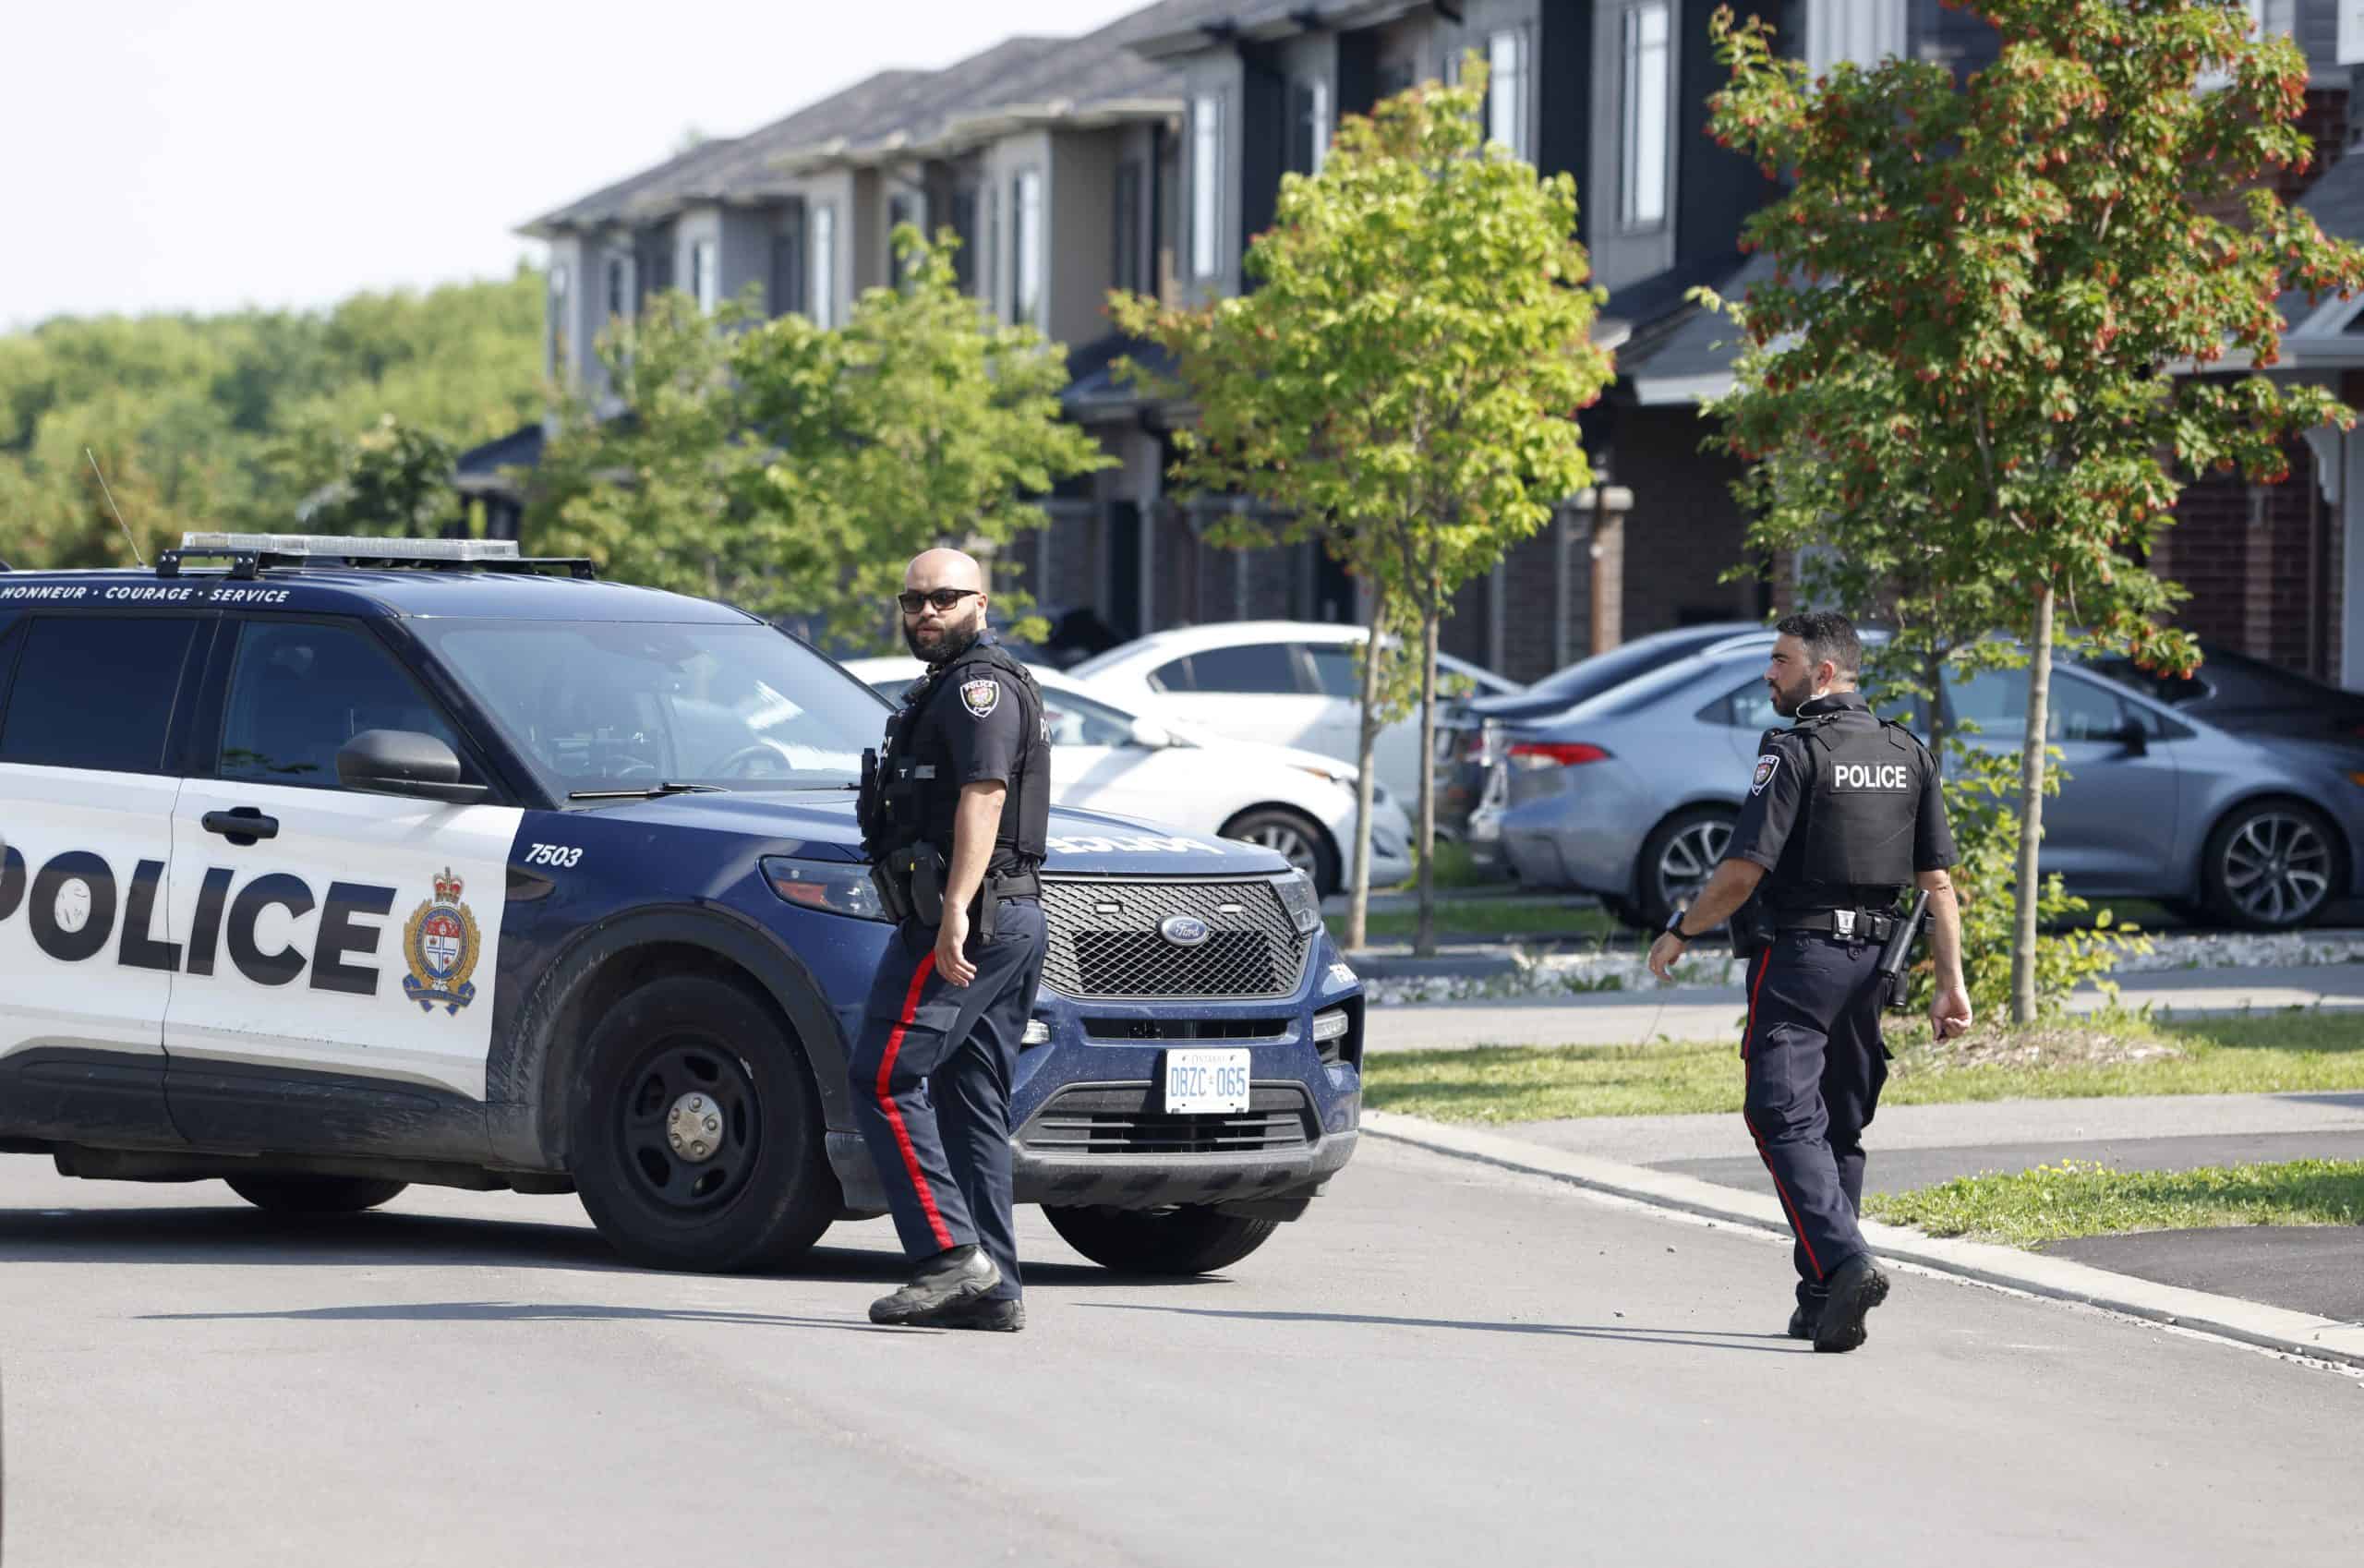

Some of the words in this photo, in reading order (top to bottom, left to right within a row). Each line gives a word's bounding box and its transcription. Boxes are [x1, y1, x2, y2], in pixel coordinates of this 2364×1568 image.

[1, 585, 87, 599] HONNEUR
[104, 586, 192, 600] COURAGE
[210, 588, 290, 603] SERVICE
[1834, 765, 1907, 789] POLICE
[525, 843, 584, 868] 7503
[1217, 1067, 1247, 1097] 065
